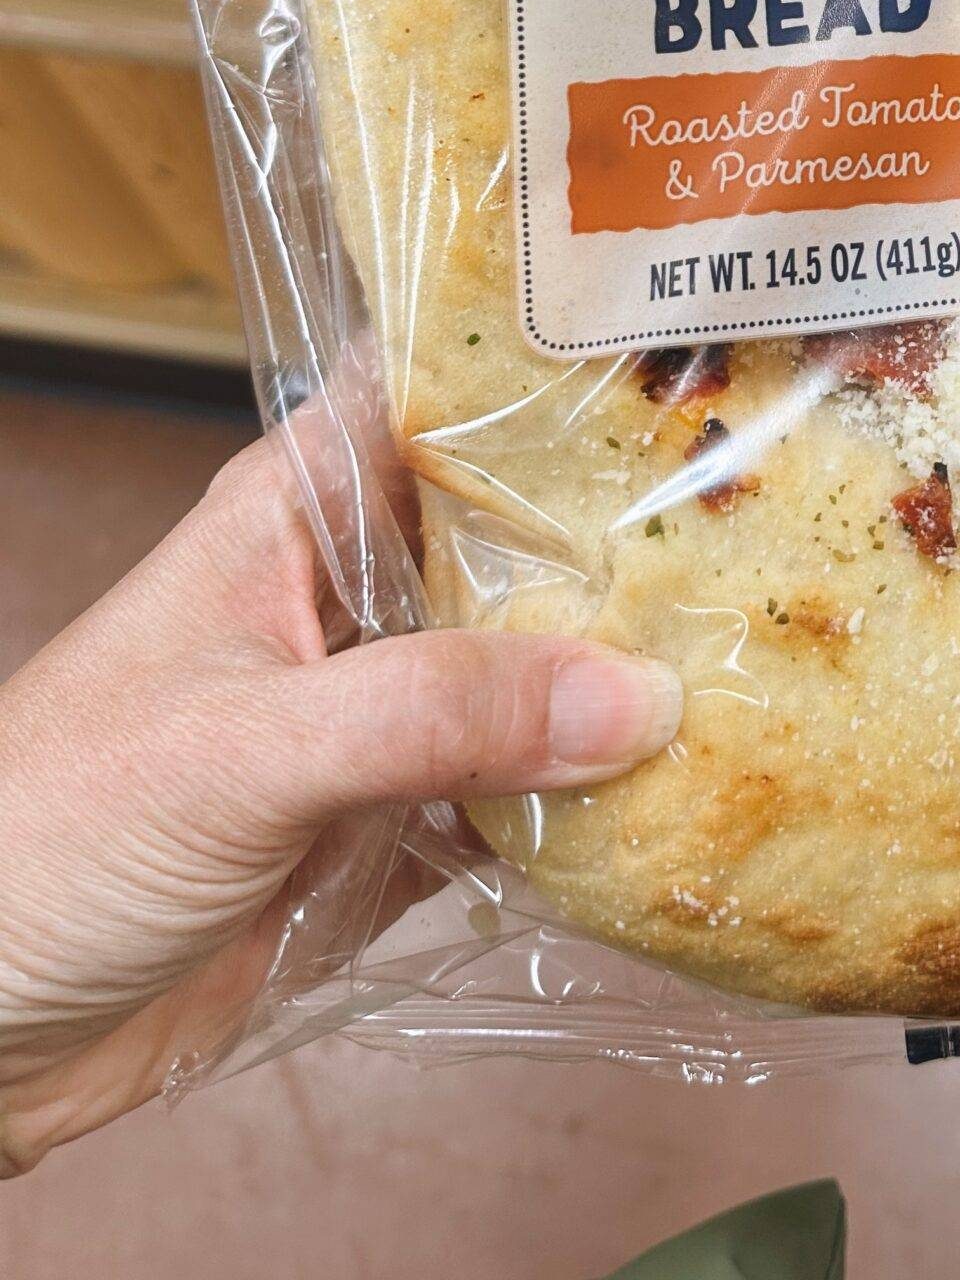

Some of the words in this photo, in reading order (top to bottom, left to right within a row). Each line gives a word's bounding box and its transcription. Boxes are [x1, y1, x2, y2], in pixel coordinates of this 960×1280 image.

[623, 89, 810, 148] Roasted
[665, 159, 699, 200] &
[712, 150, 930, 194] Parmesan
[650, 256, 700, 301] NET
[708, 251, 756, 294] WT.
[765, 245, 821, 289] 14.5
[831, 241, 868, 283] OZ
